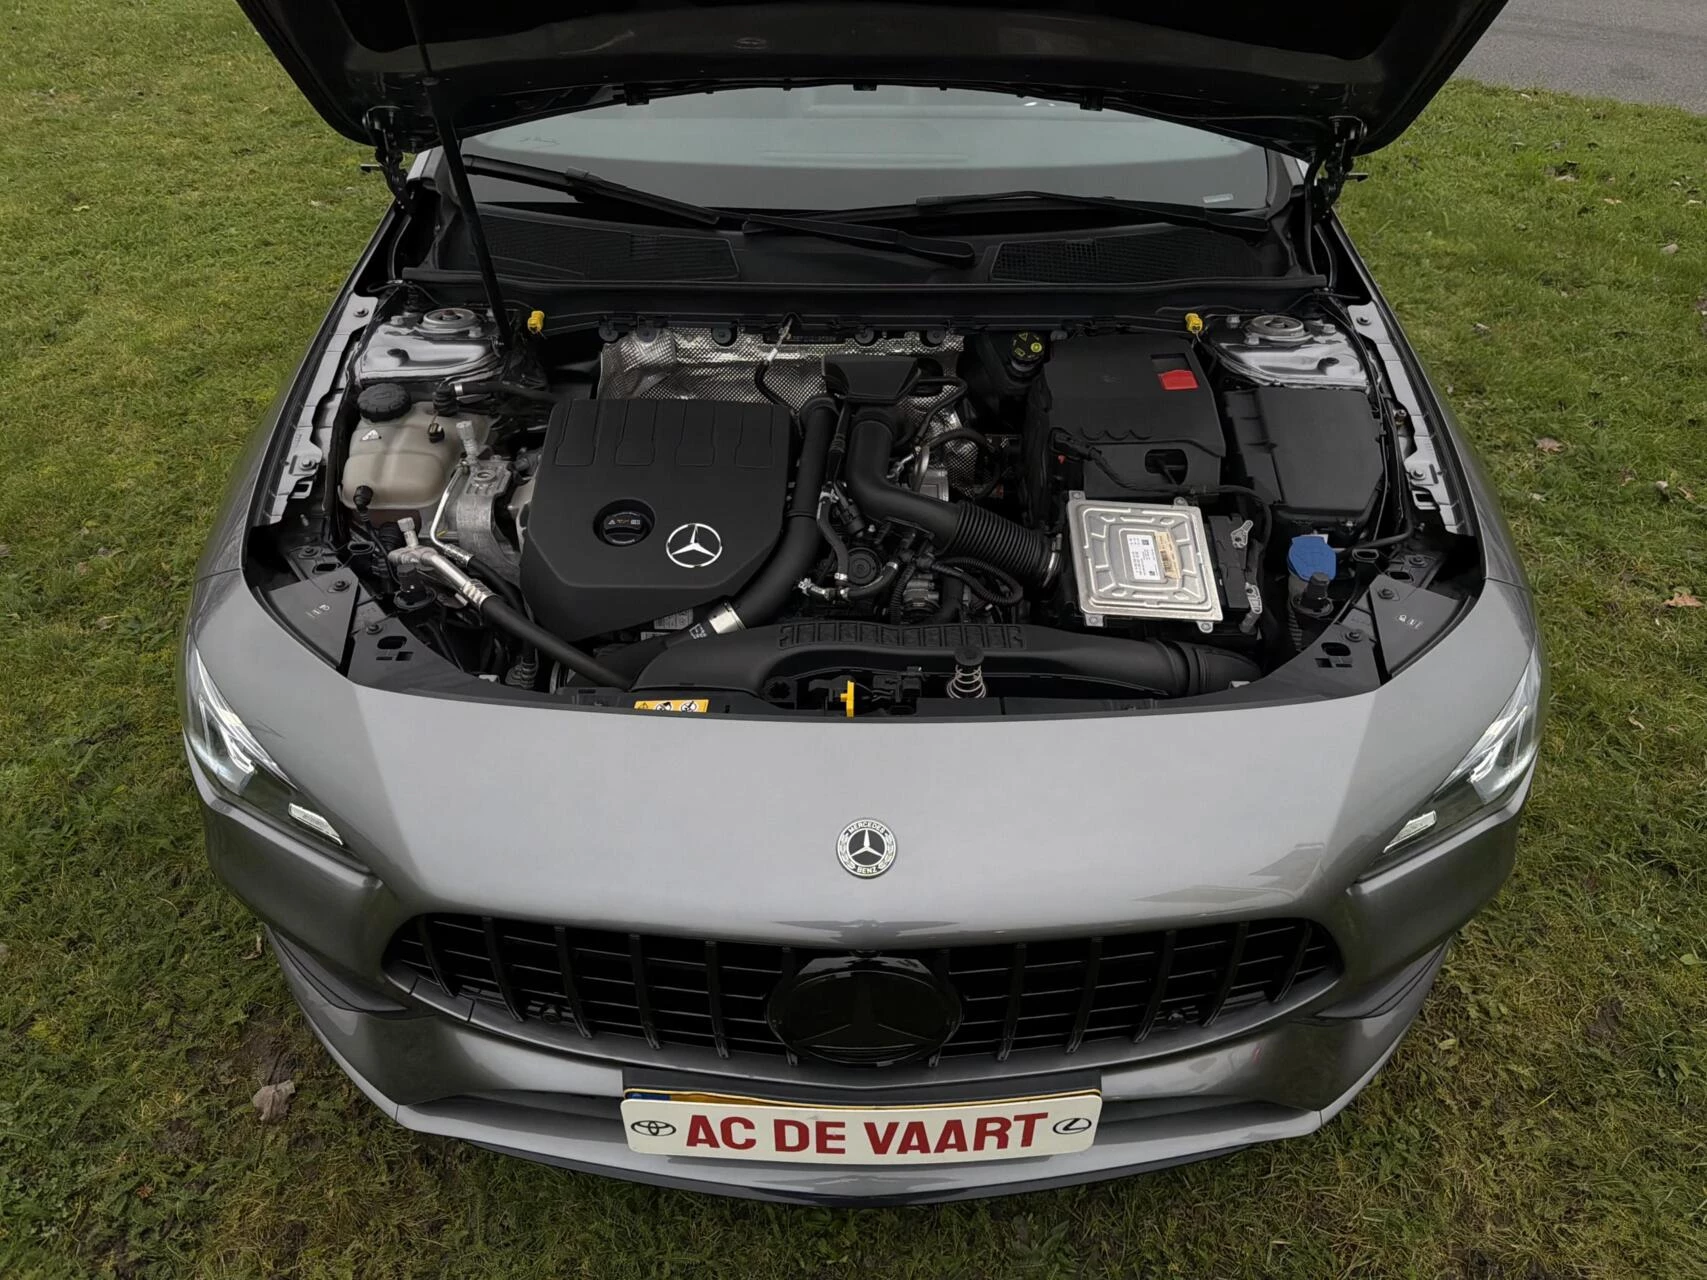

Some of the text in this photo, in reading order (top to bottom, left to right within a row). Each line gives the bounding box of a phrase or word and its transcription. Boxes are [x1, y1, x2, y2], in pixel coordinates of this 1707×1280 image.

[848, 821, 885, 833] MERCEDES
[857, 866, 877, 874] BENZ
[688, 1113, 1049, 1155] AC DE VAART
